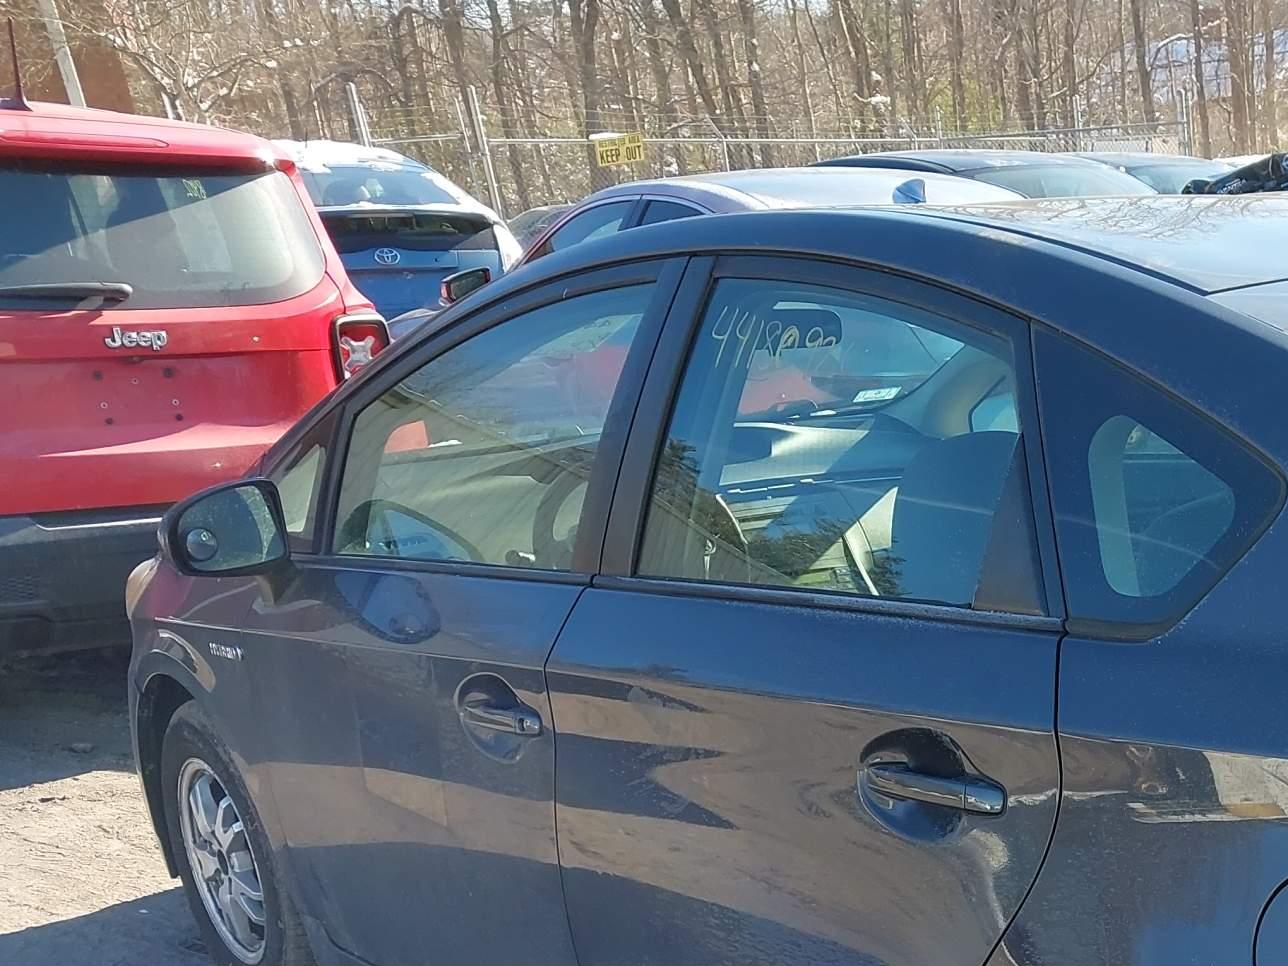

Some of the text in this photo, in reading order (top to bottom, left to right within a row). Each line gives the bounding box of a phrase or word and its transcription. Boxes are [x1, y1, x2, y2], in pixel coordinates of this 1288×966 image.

[599, 144, 642, 165] KEEP OUT
[104, 326, 168, 351] Jeep
